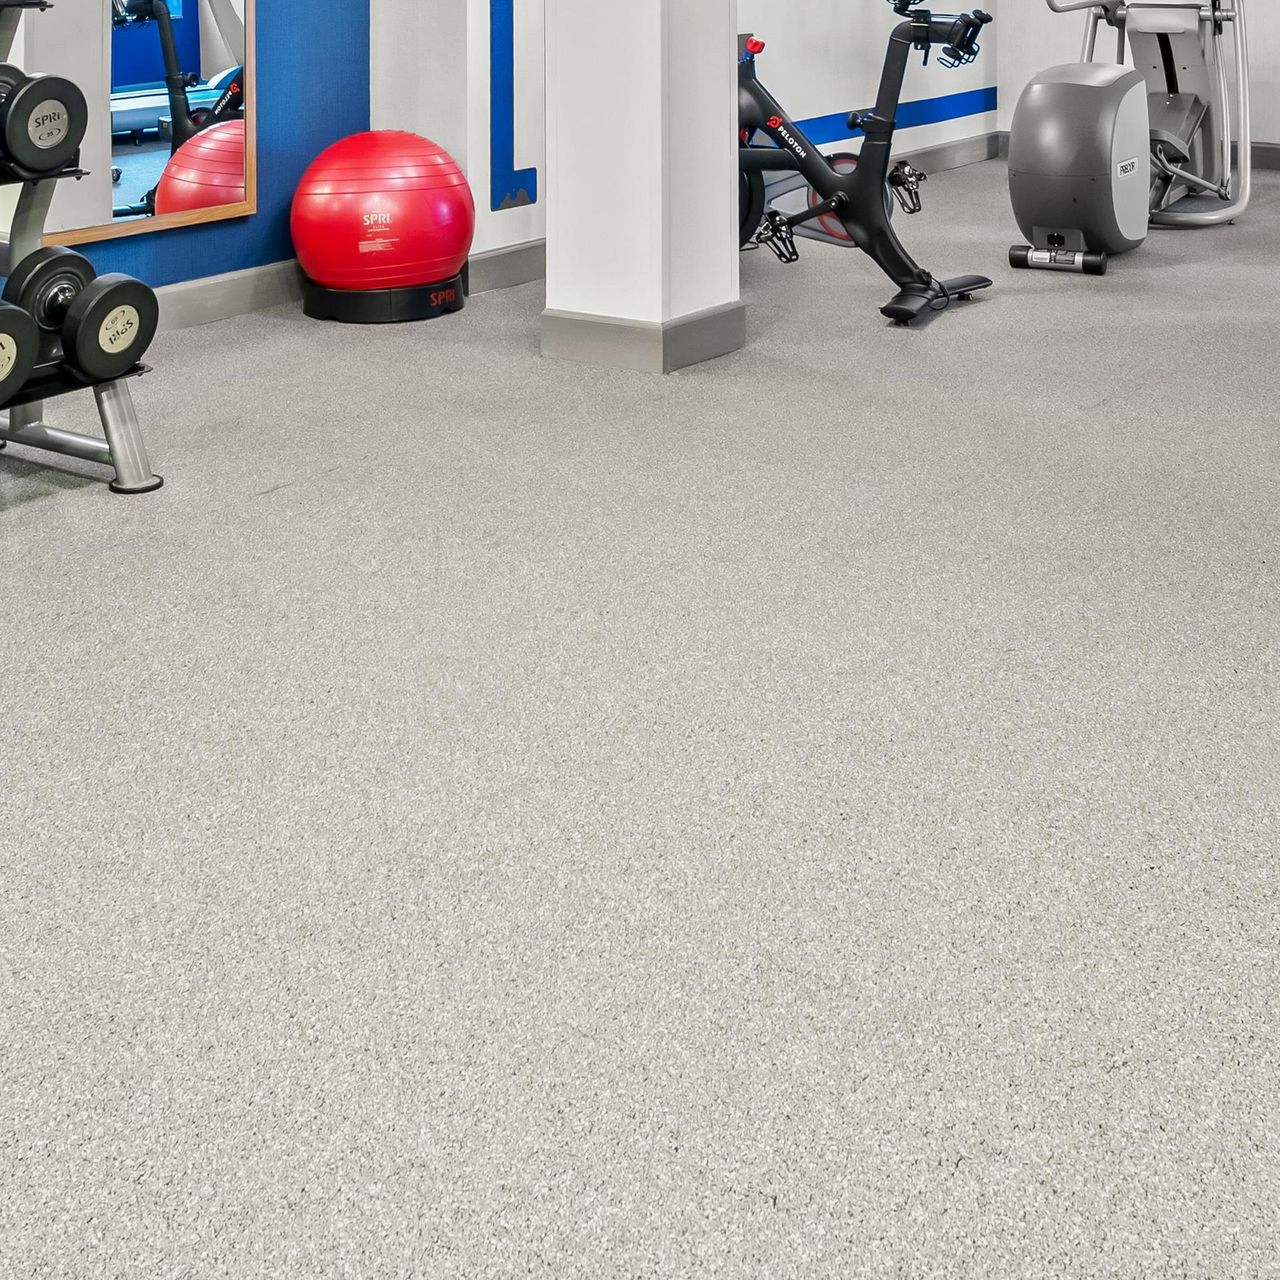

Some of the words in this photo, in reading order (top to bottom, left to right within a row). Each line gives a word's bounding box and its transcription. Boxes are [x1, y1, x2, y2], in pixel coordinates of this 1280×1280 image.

[35, 112, 60, 127] SPRI
[778, 126, 806, 158] PELOTON
[363, 213, 390, 225] SPRI
[430, 289, 456, 307] SPRI
